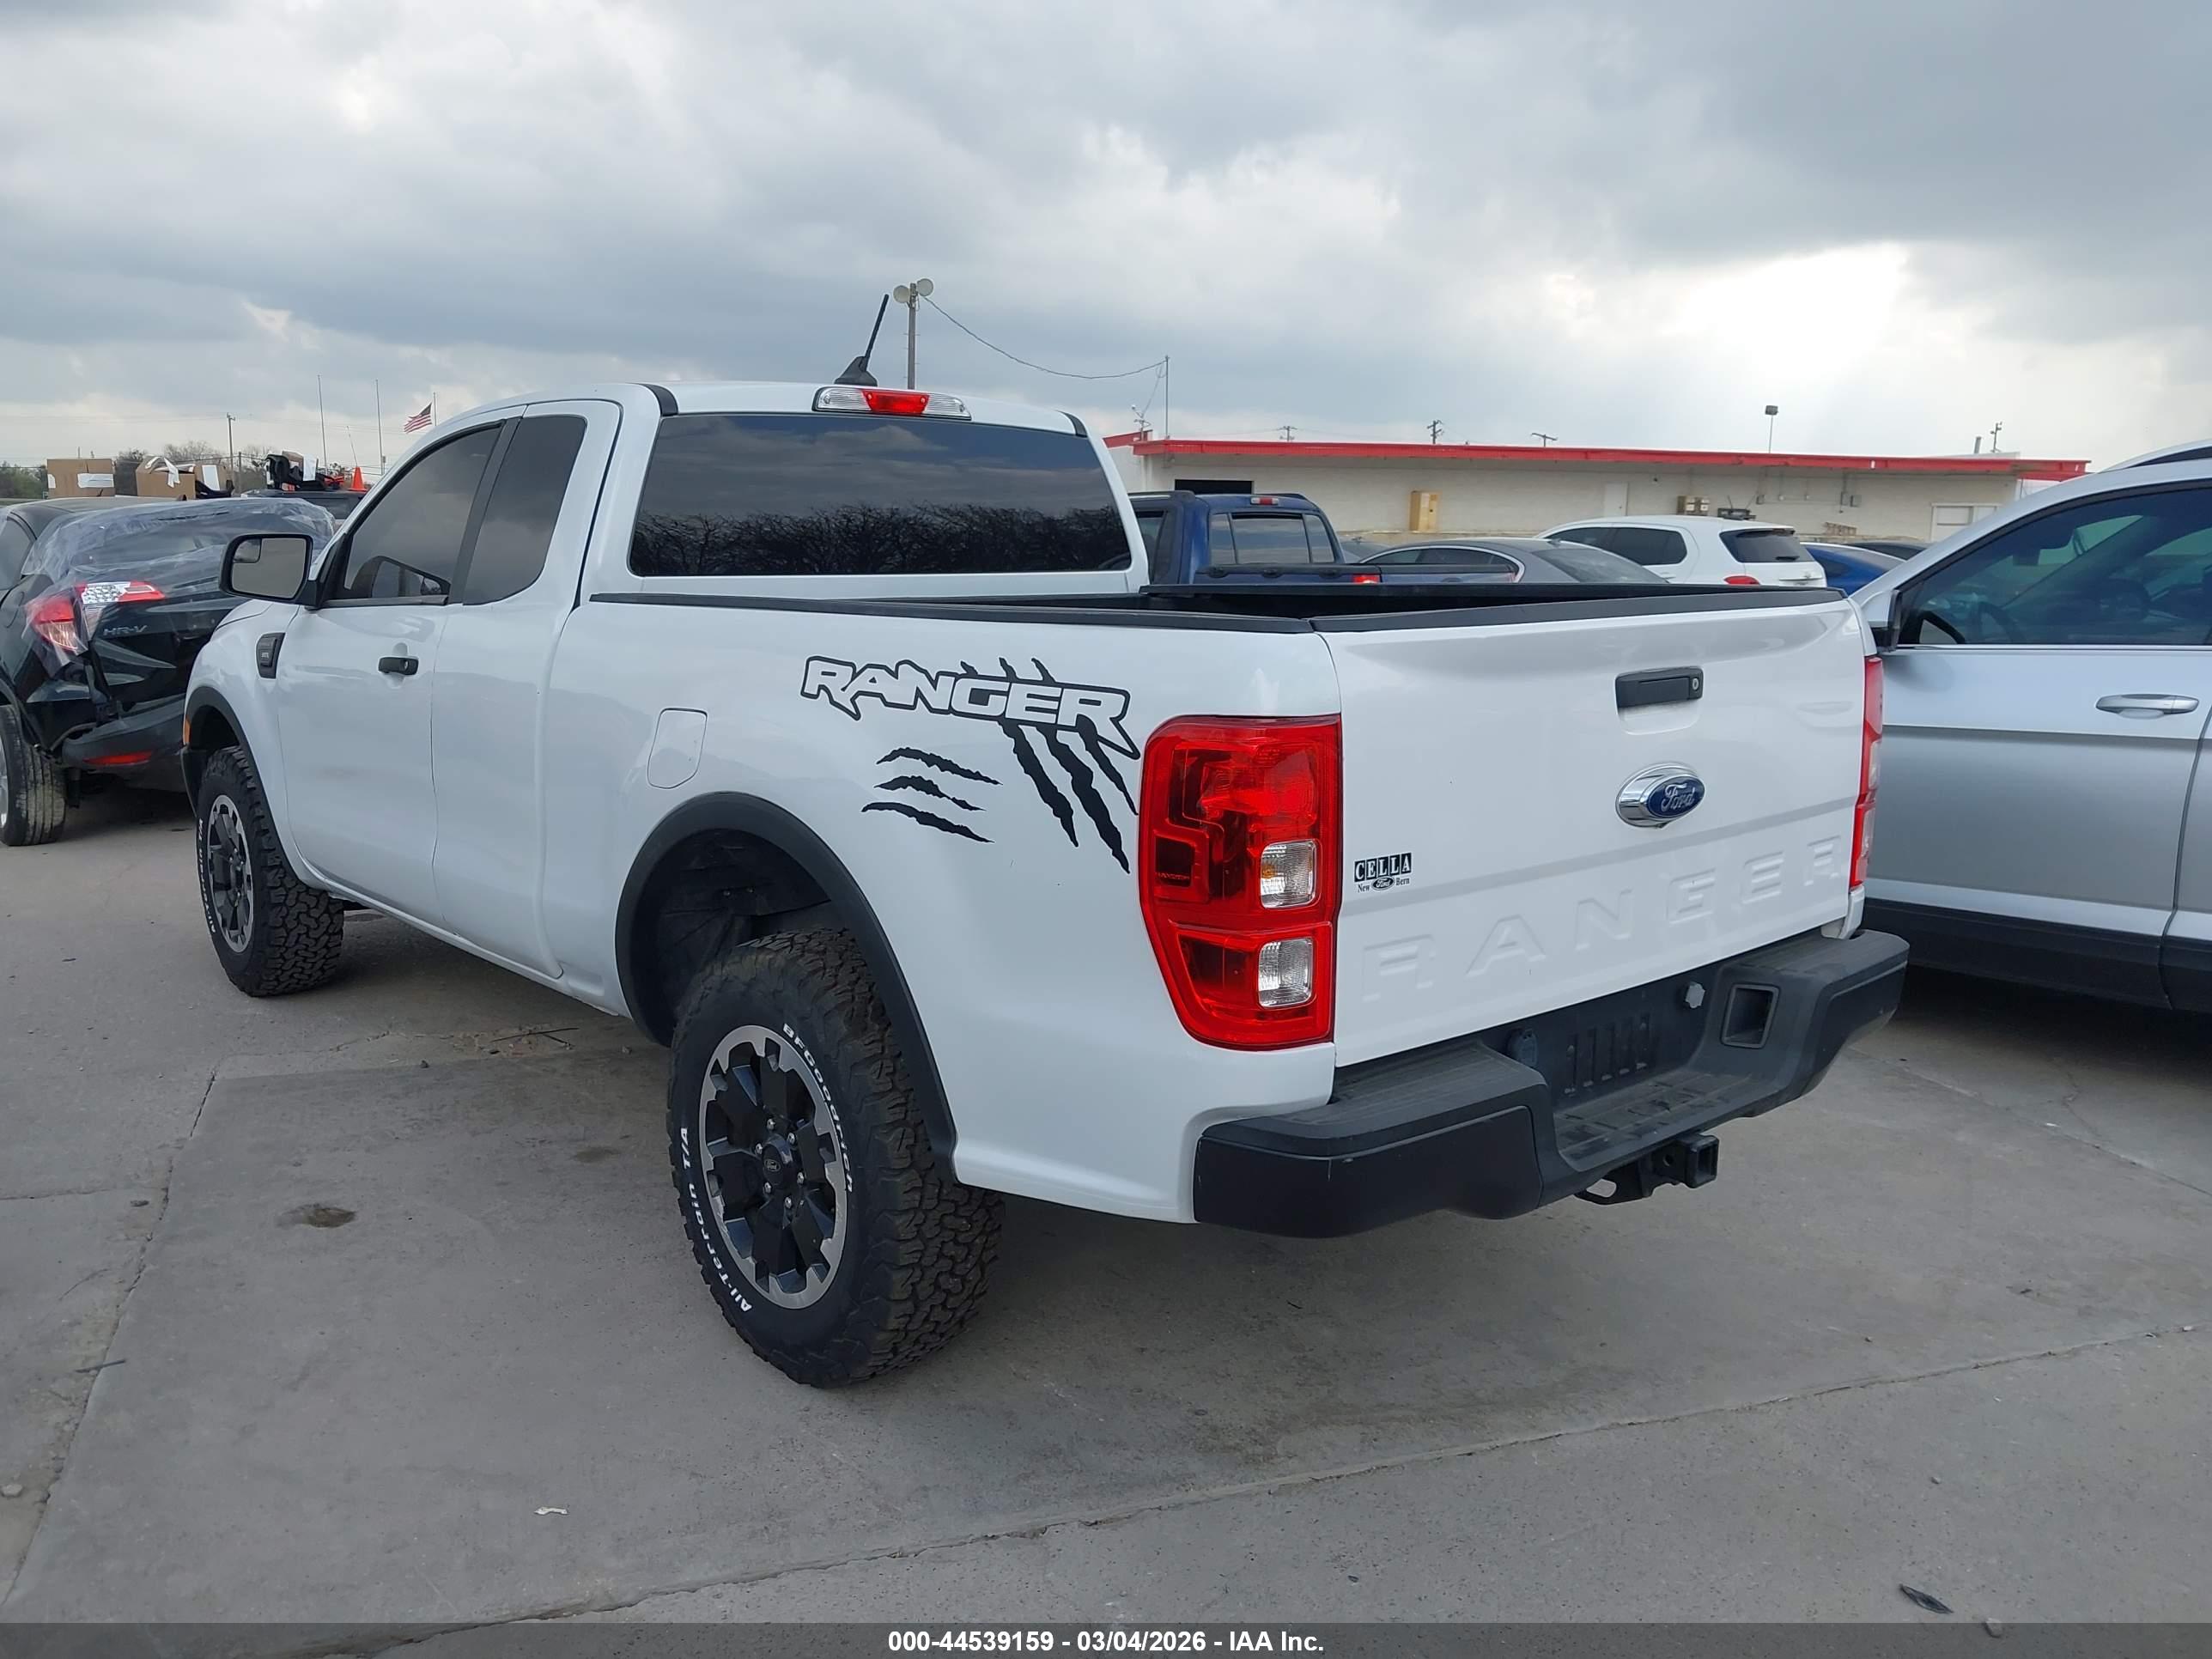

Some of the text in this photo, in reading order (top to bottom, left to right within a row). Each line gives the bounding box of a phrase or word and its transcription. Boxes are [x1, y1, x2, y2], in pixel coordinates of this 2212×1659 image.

[103, 624, 148, 635] HR-V
[800, 656, 1140, 760] RANGER
[1661, 782, 1696, 812] Ford
[1354, 853, 1412, 882] CELLA
[1358, 884, 1370, 893] New
[1395, 877, 1410, 886] Bern
[1362, 835, 1841, 1003] RANGER
[783, 1022, 854, 1193] BFGoodrich
[680, 1127, 752, 1312] All-Terrain T/A
